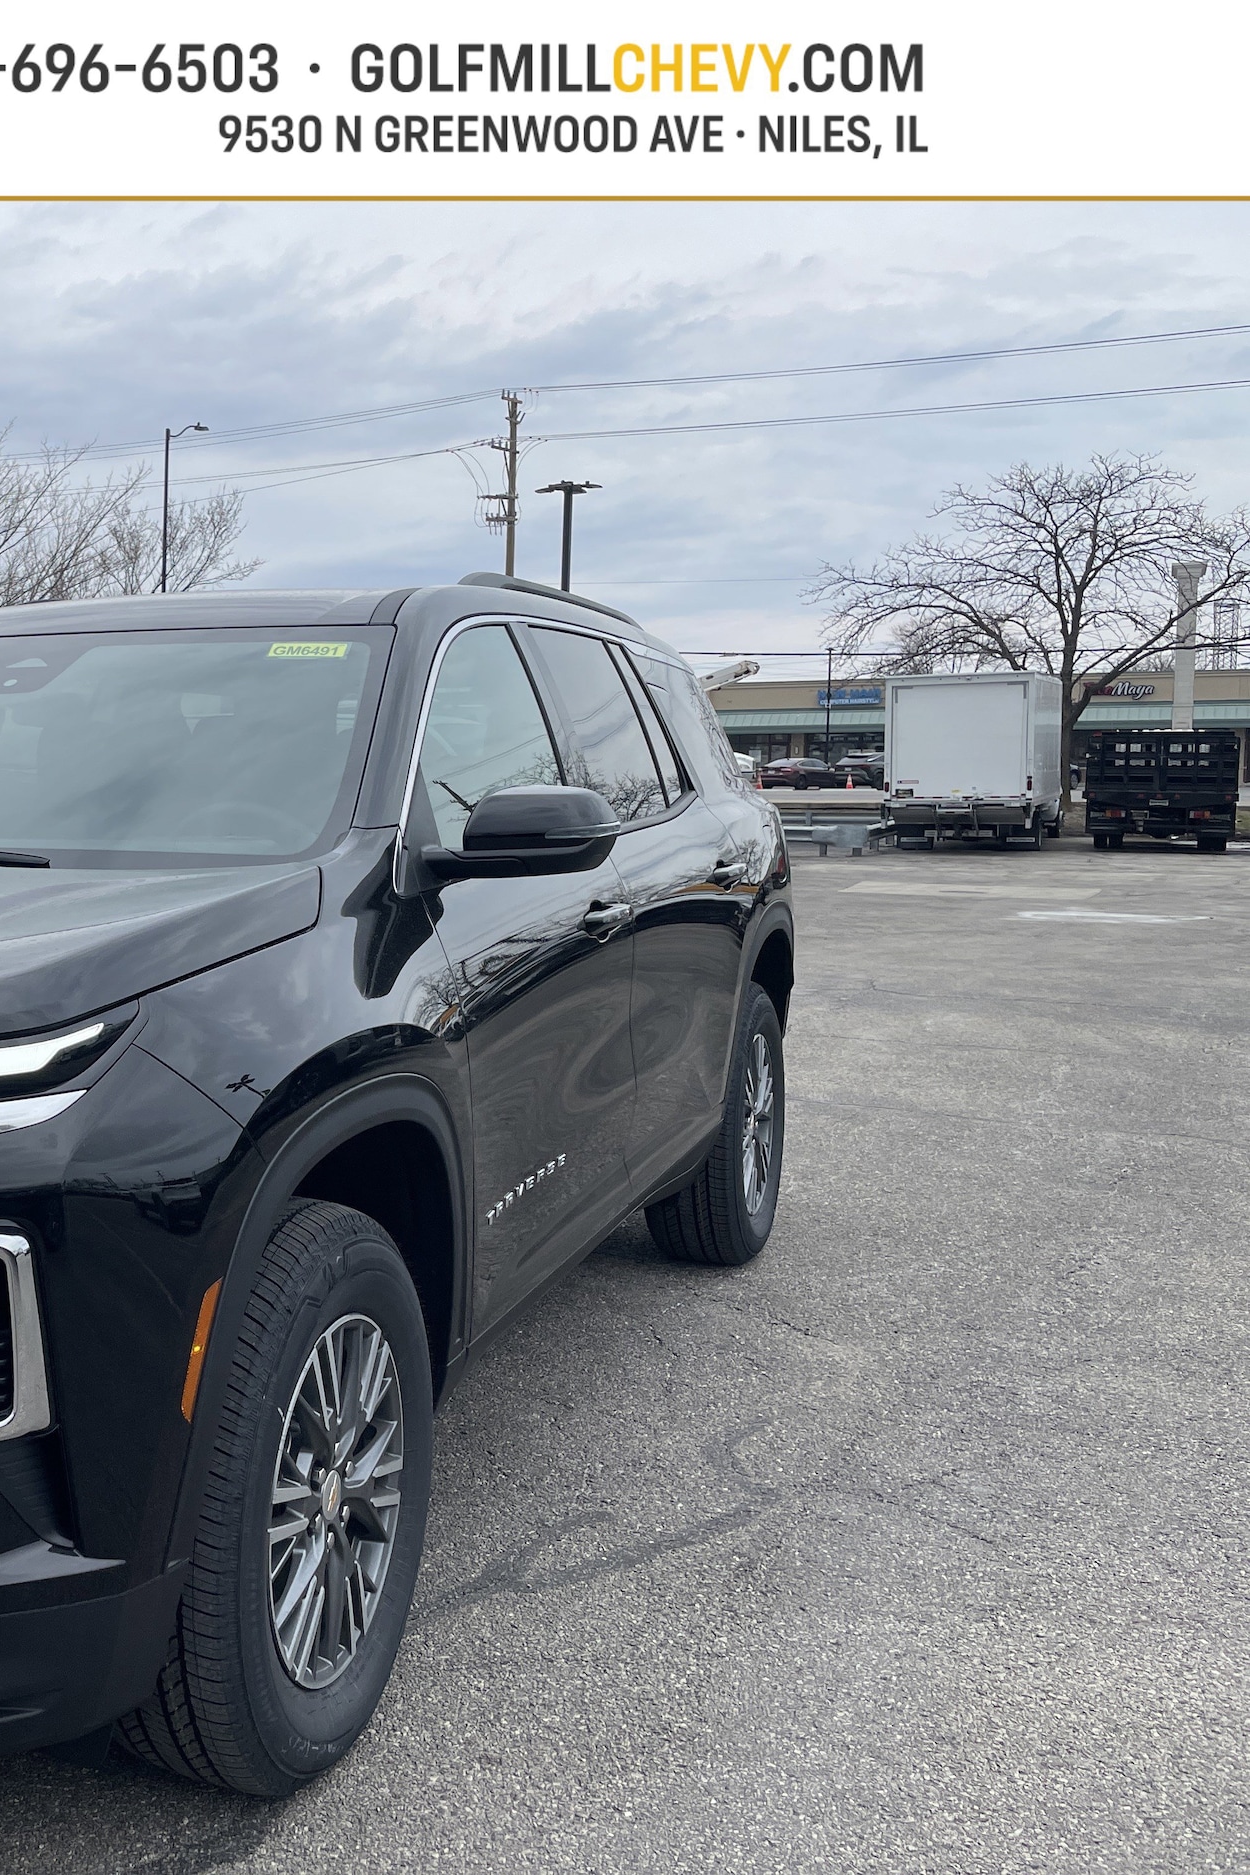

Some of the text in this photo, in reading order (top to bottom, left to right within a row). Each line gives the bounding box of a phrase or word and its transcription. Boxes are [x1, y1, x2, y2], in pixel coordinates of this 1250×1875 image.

[273, 645, 340, 656] GM6491
[1111, 681, 1155, 700] Maya
[485, 1153, 566, 1226] TRAVERSE
